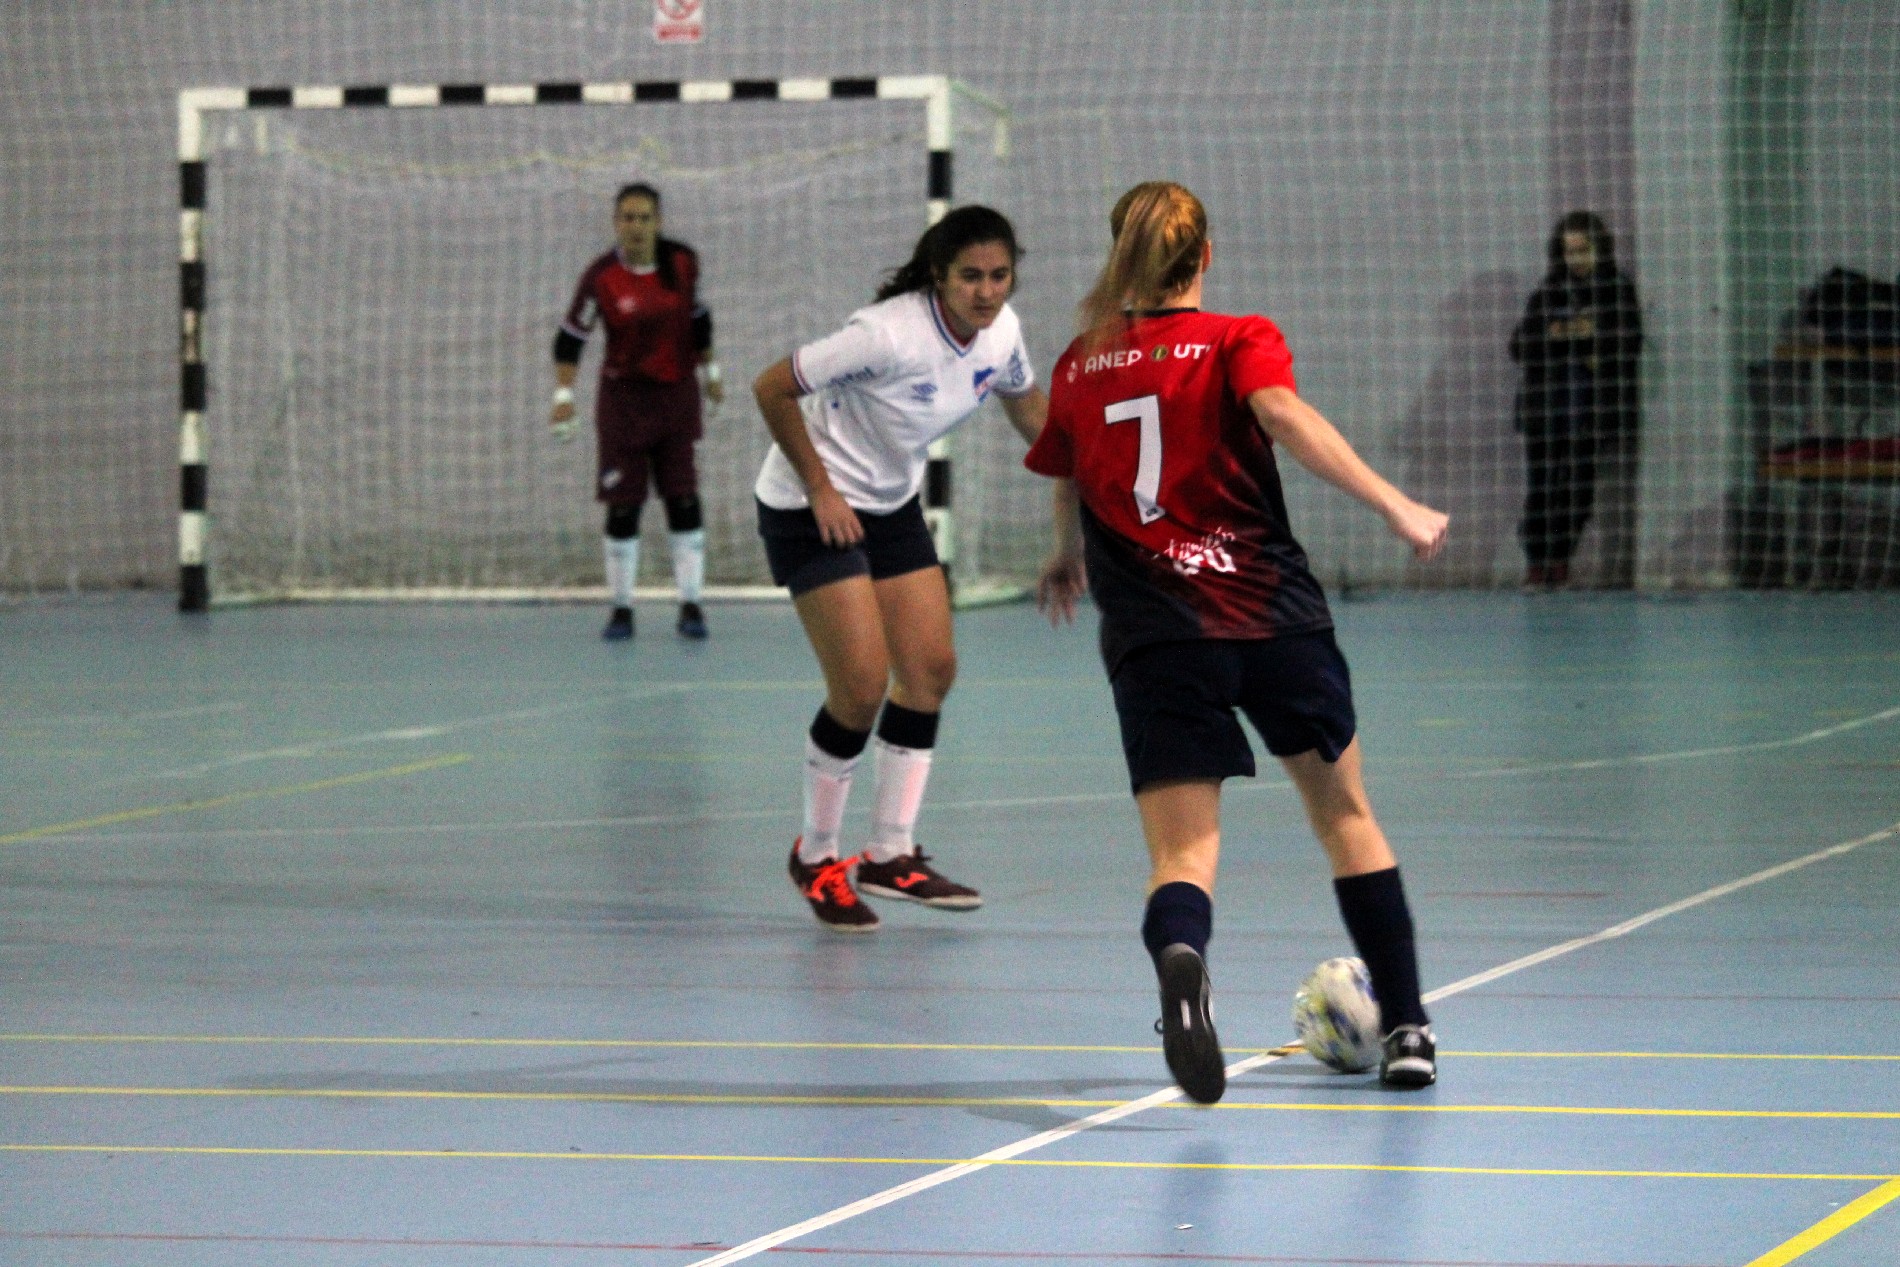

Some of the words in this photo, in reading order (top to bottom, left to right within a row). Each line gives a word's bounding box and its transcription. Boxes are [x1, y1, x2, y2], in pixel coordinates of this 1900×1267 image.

[1084, 349, 1143, 374] ANEP
[1173, 343, 1212, 361] UT
[1104, 394, 1166, 525] 7
